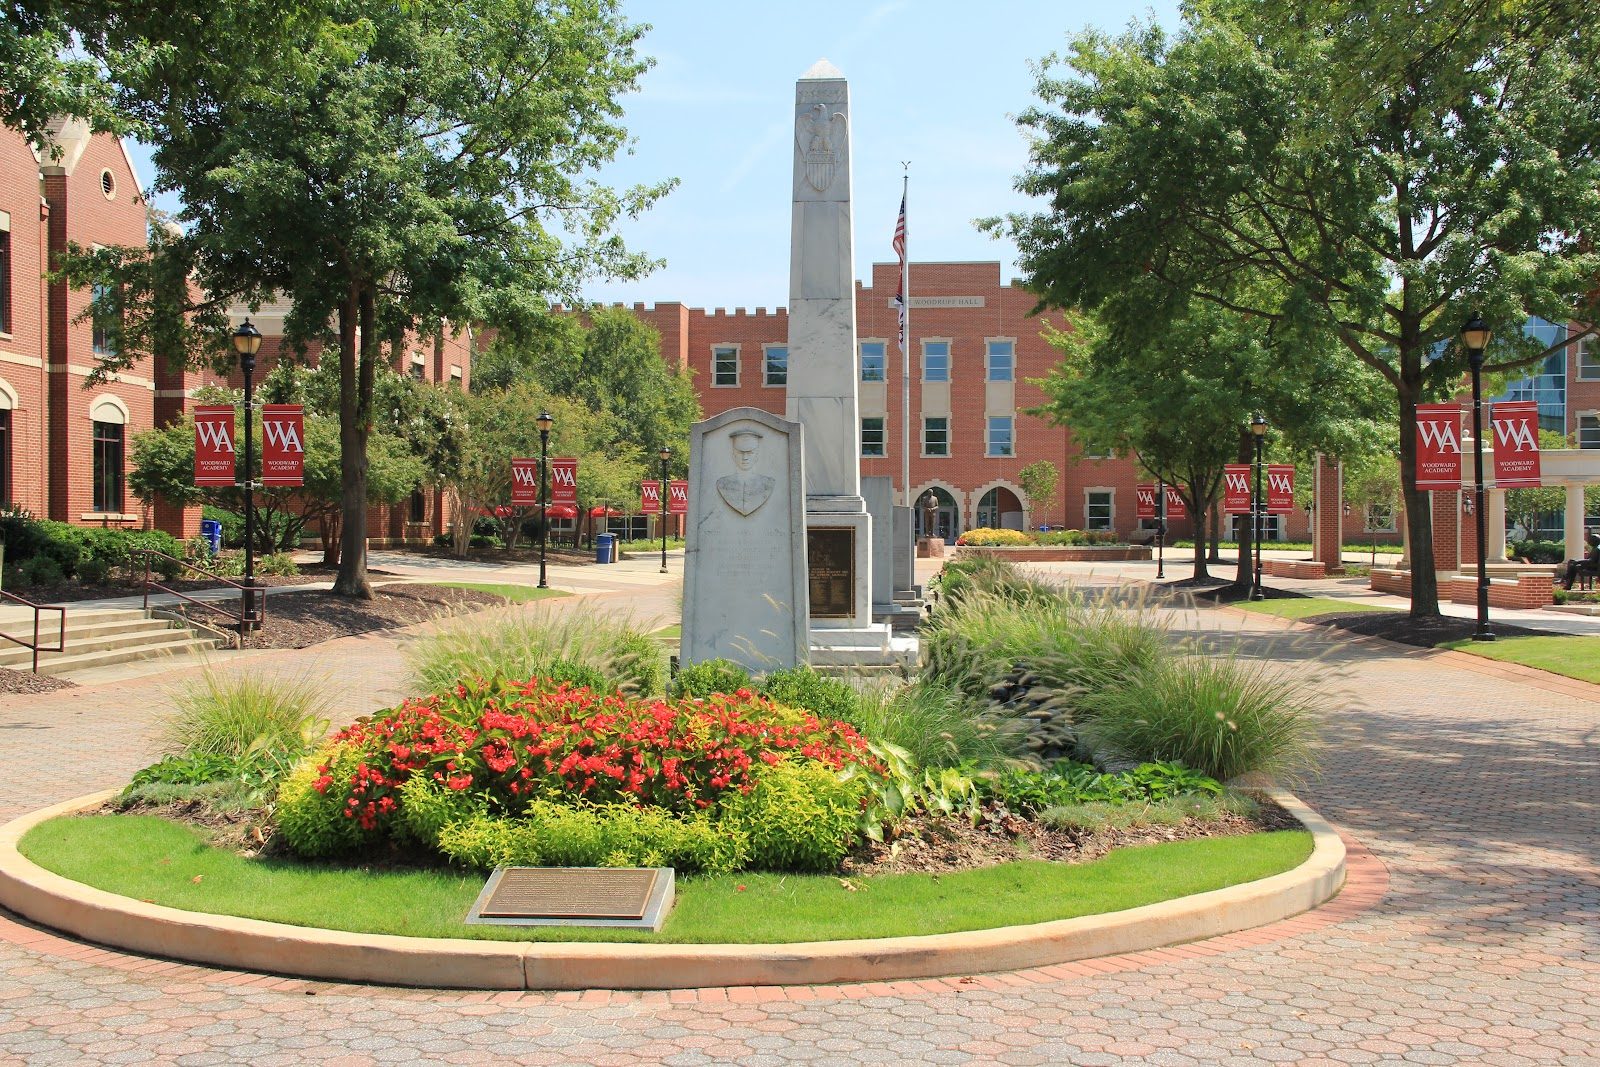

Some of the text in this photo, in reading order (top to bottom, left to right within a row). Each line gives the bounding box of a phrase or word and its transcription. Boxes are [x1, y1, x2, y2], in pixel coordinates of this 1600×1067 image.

[195, 421, 235, 453] WA
[262, 421, 304, 453] WA
[1416, 420, 1461, 454] WA
[1492, 418, 1540, 452] WA
[512, 467, 536, 487] WA
[552, 467, 577, 487] WA
[1225, 473, 1250, 494] WA
[1268, 473, 1294, 494] WA
[642, 486, 660, 501] WA
[670, 486, 688, 501] WA
[1137, 491, 1155, 505] WA
